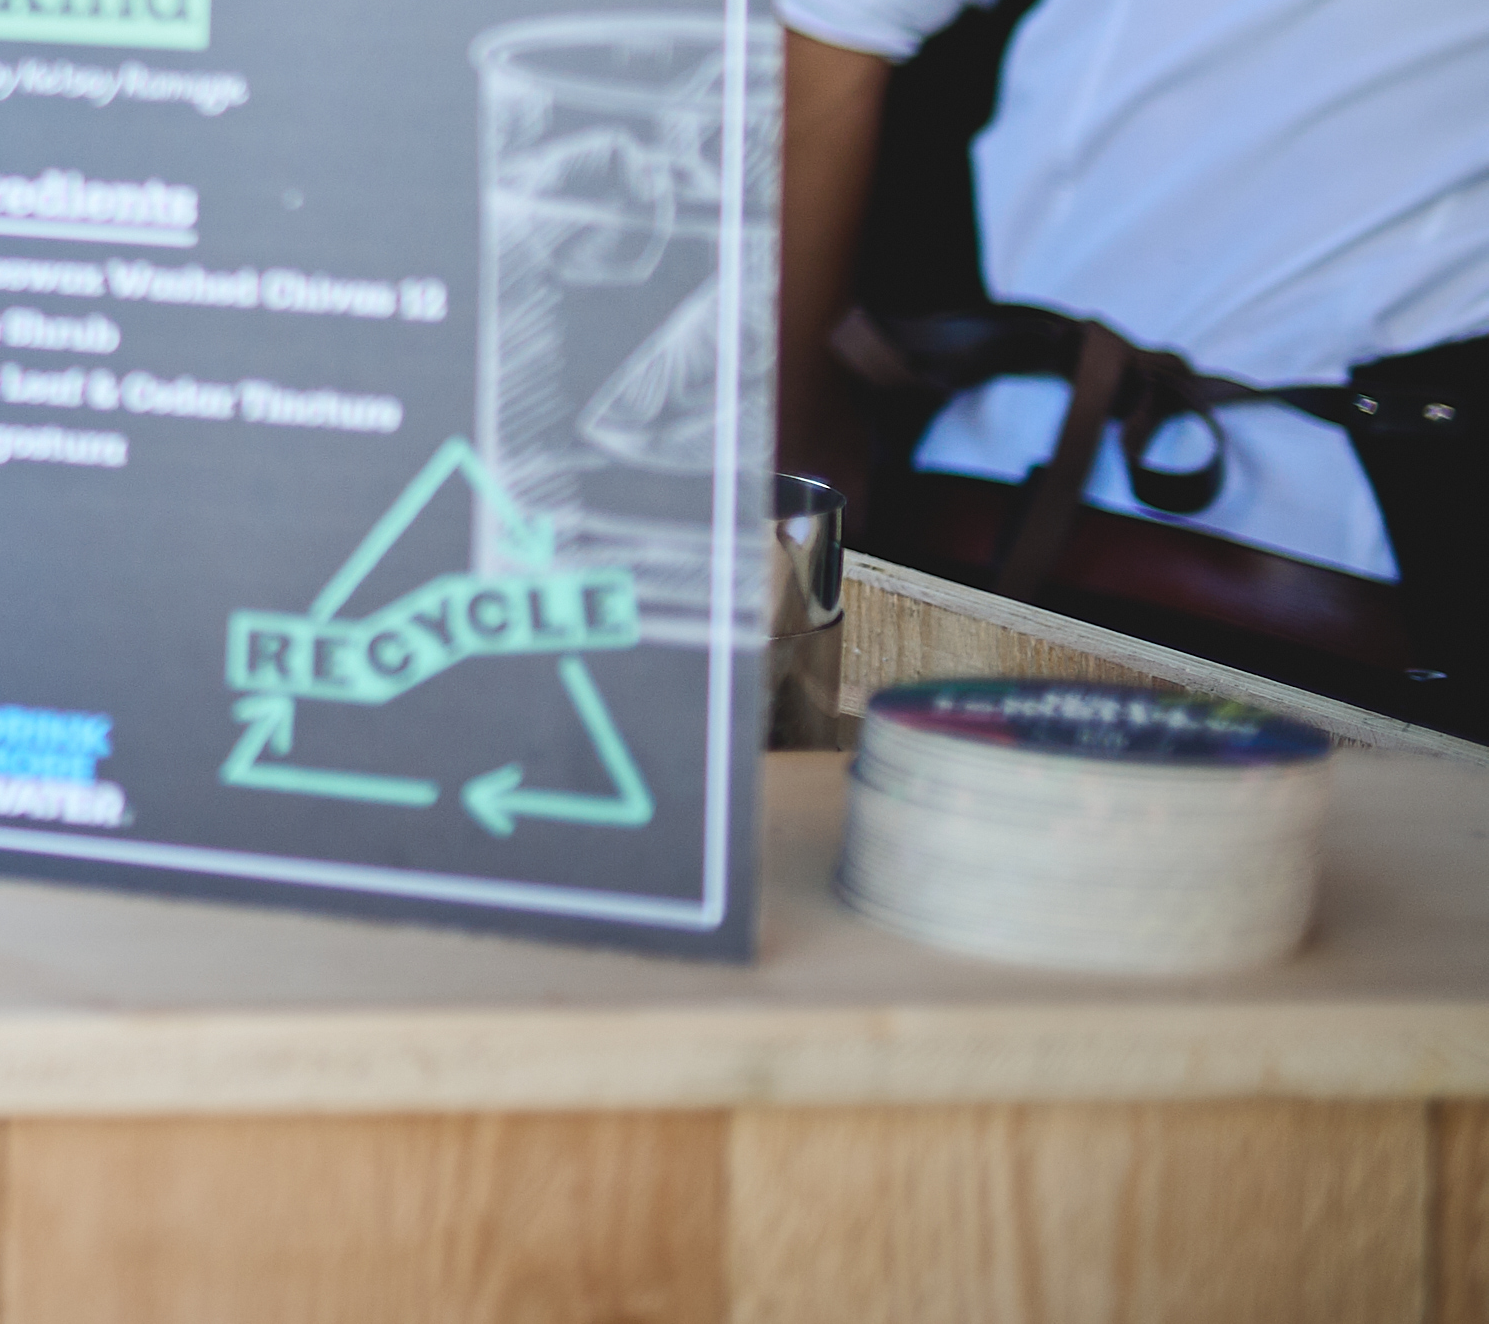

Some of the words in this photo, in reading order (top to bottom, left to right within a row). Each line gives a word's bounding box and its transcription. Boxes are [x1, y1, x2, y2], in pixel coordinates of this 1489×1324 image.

[105, 256, 260, 310] Washed
[259, 265, 398, 320] Chivas
[0, 359, 86, 410] Leaf
[85, 366, 121, 412] &
[234, 378, 404, 434] Tincture
[246, 586, 623, 687] RECYCLE
